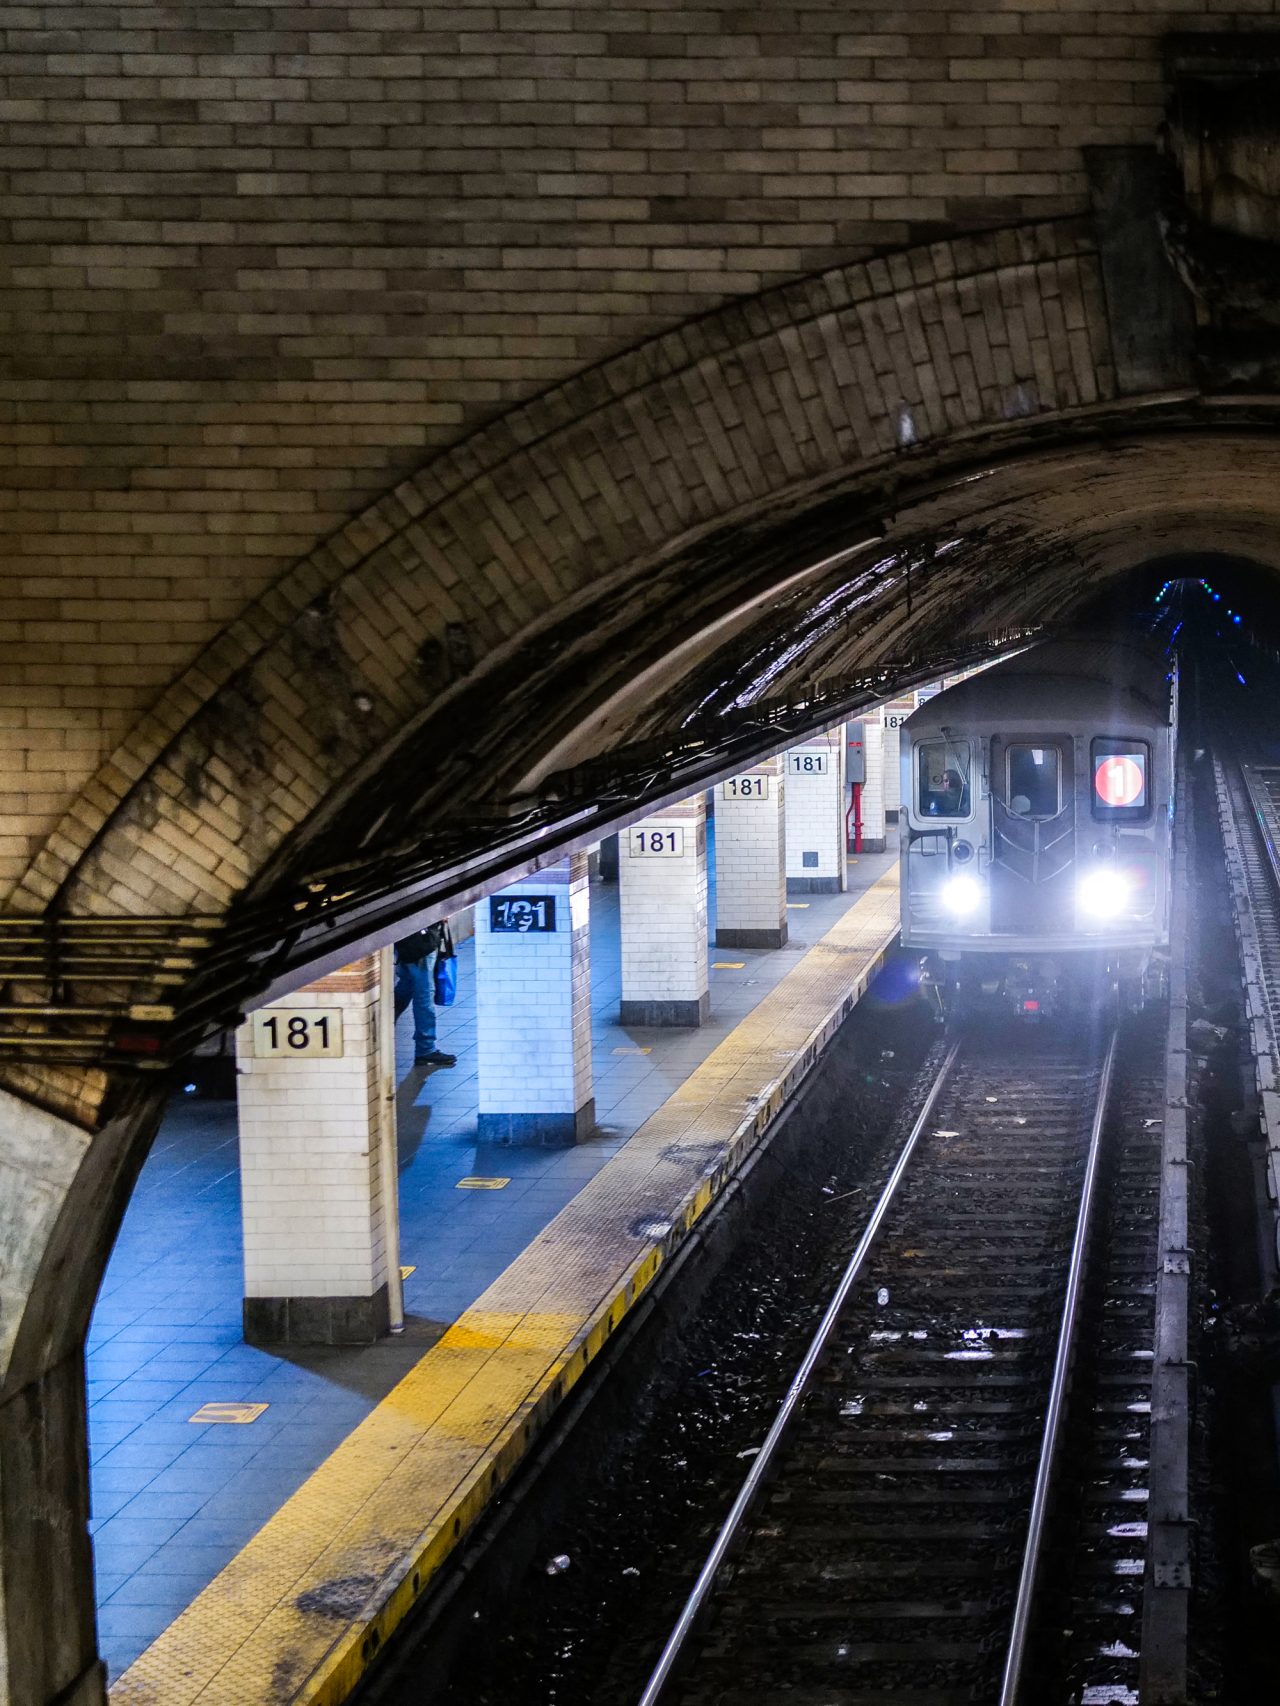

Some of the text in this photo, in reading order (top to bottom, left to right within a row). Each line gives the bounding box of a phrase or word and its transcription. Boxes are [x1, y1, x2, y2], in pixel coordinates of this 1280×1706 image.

[793, 756, 822, 771] 181
[728, 778, 762, 796] 181
[1107, 765, 1125, 798] 1
[636, 832, 675, 852] 181
[262, 1016, 330, 1049] 181
